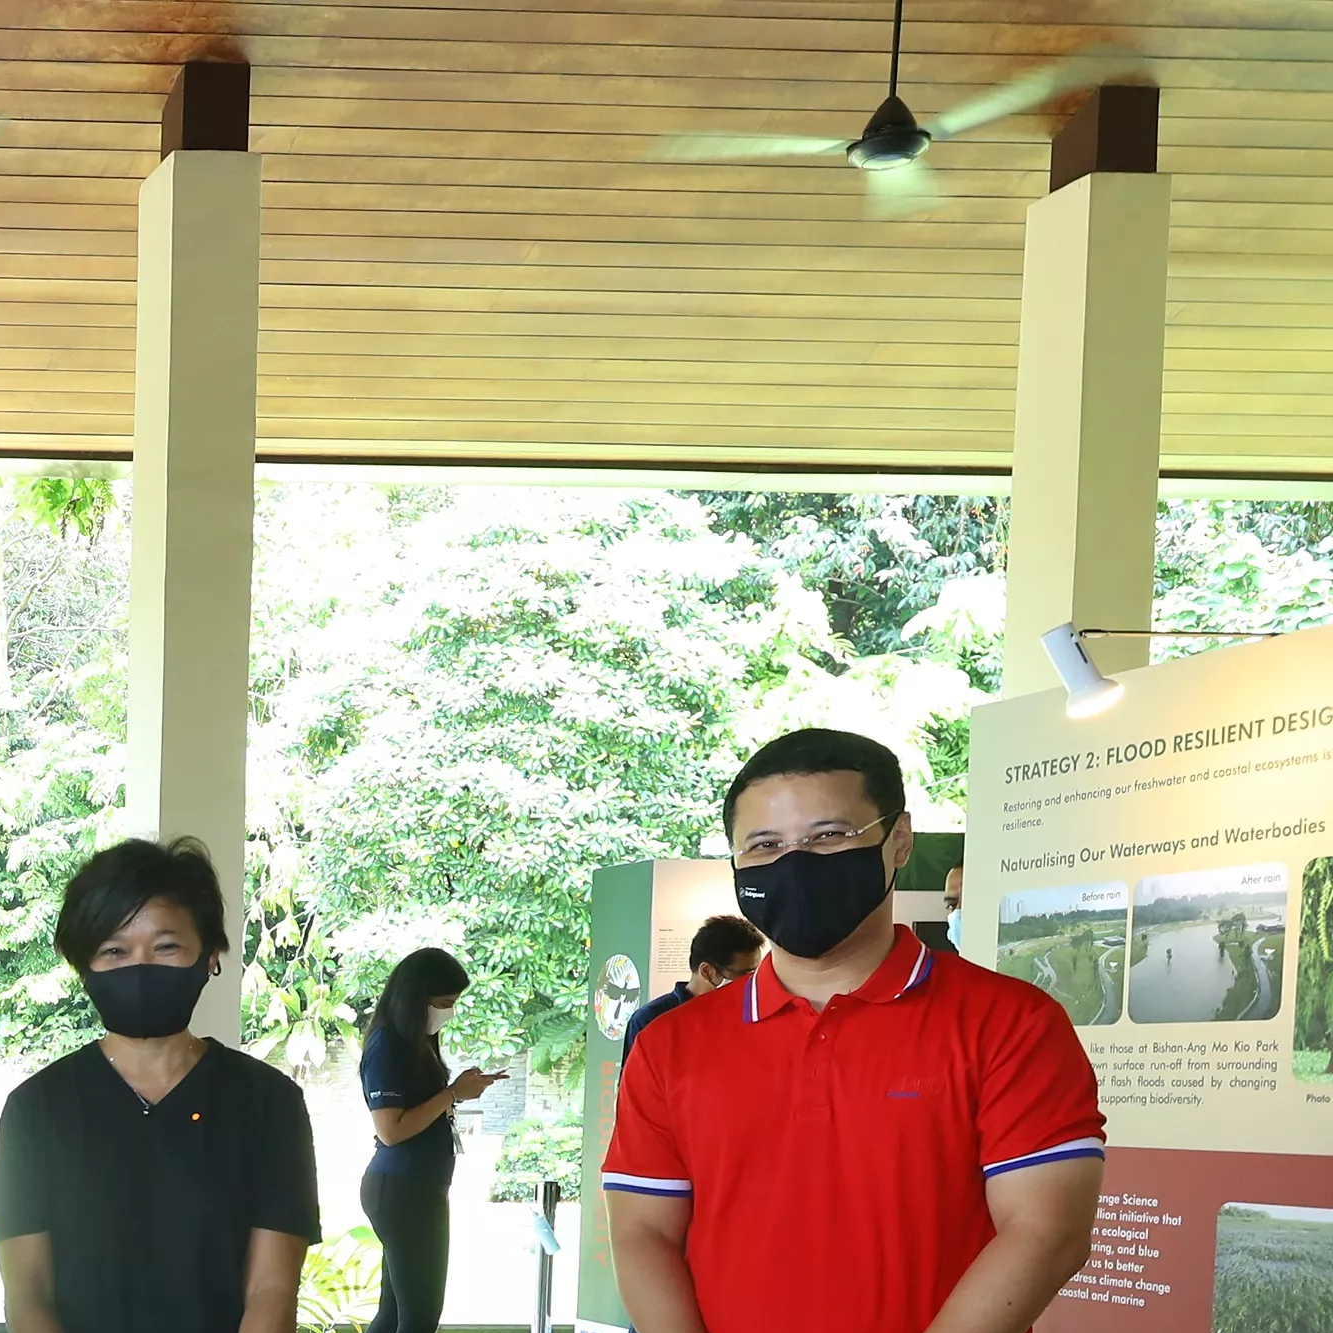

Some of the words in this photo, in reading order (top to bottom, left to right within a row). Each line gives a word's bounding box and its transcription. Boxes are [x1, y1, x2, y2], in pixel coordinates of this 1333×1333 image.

[1004, 753, 1081, 785] STRATEGY
[1085, 751, 1100, 770] 2:
[1106, 738, 1167, 766] FLOOD
[1172, 718, 1265, 754] RESILIENT
[1272, 706, 1333, 735] DESIG
[1003, 798, 1043, 814] Restoring
[1044, 792, 1062, 807] and
[1063, 785, 1113, 804] enhancing
[1114, 784, 1132, 796] our
[1133, 774, 1187, 792] freshwater
[1189, 767, 1210, 783] and
[1212, 761, 1251, 779] coastal
[1254, 752, 1319, 771] ecosystems
[1001, 814, 1045, 832] resilience.
[1000, 850, 1076, 873] Naturalising
[1079, 847, 1106, 863] Our
[1109, 839, 1186, 860] Waterways
[1190, 829, 1219, 849] and
[1224, 817, 1326, 844] Waterbodies
[1240, 874, 1262, 886] After
[1263, 874, 1281, 883] rain
[1081, 891, 1105, 903] Before
[1106, 889, 1121, 900] rain
[1089, 1042, 1106, 1055] like
[1109, 1042, 1134, 1055] those
[1138, 1043, 1148, 1054] at
[1152, 1041, 1207, 1057] Bishan-Ang
[1211, 1041, 1229, 1054] Mo
[1233, 1040, 1251, 1053] Kio
[1255, 1039, 1279, 1053] Park
[1110, 1075, 1133, 1089] flash
[1137, 1075, 1166, 1089] floods
[1170, 1074, 1205, 1088] caused
[1210, 1074, 1224, 1091] by
[1228, 1075, 1277, 1091] changing
[1099, 1091, 1148, 1107] supporting
[1149, 1091, 1204, 1108] biodiversity.
[1122, 1193, 1159, 1208] Science
[1119, 1209, 1160, 1225] initiative
[1161, 1212, 1182, 1226] that
[1057, 1287, 1090, 1300] coastal
[1090, 1290, 1110, 1302] and
[1111, 1293, 1145, 1307] marine
